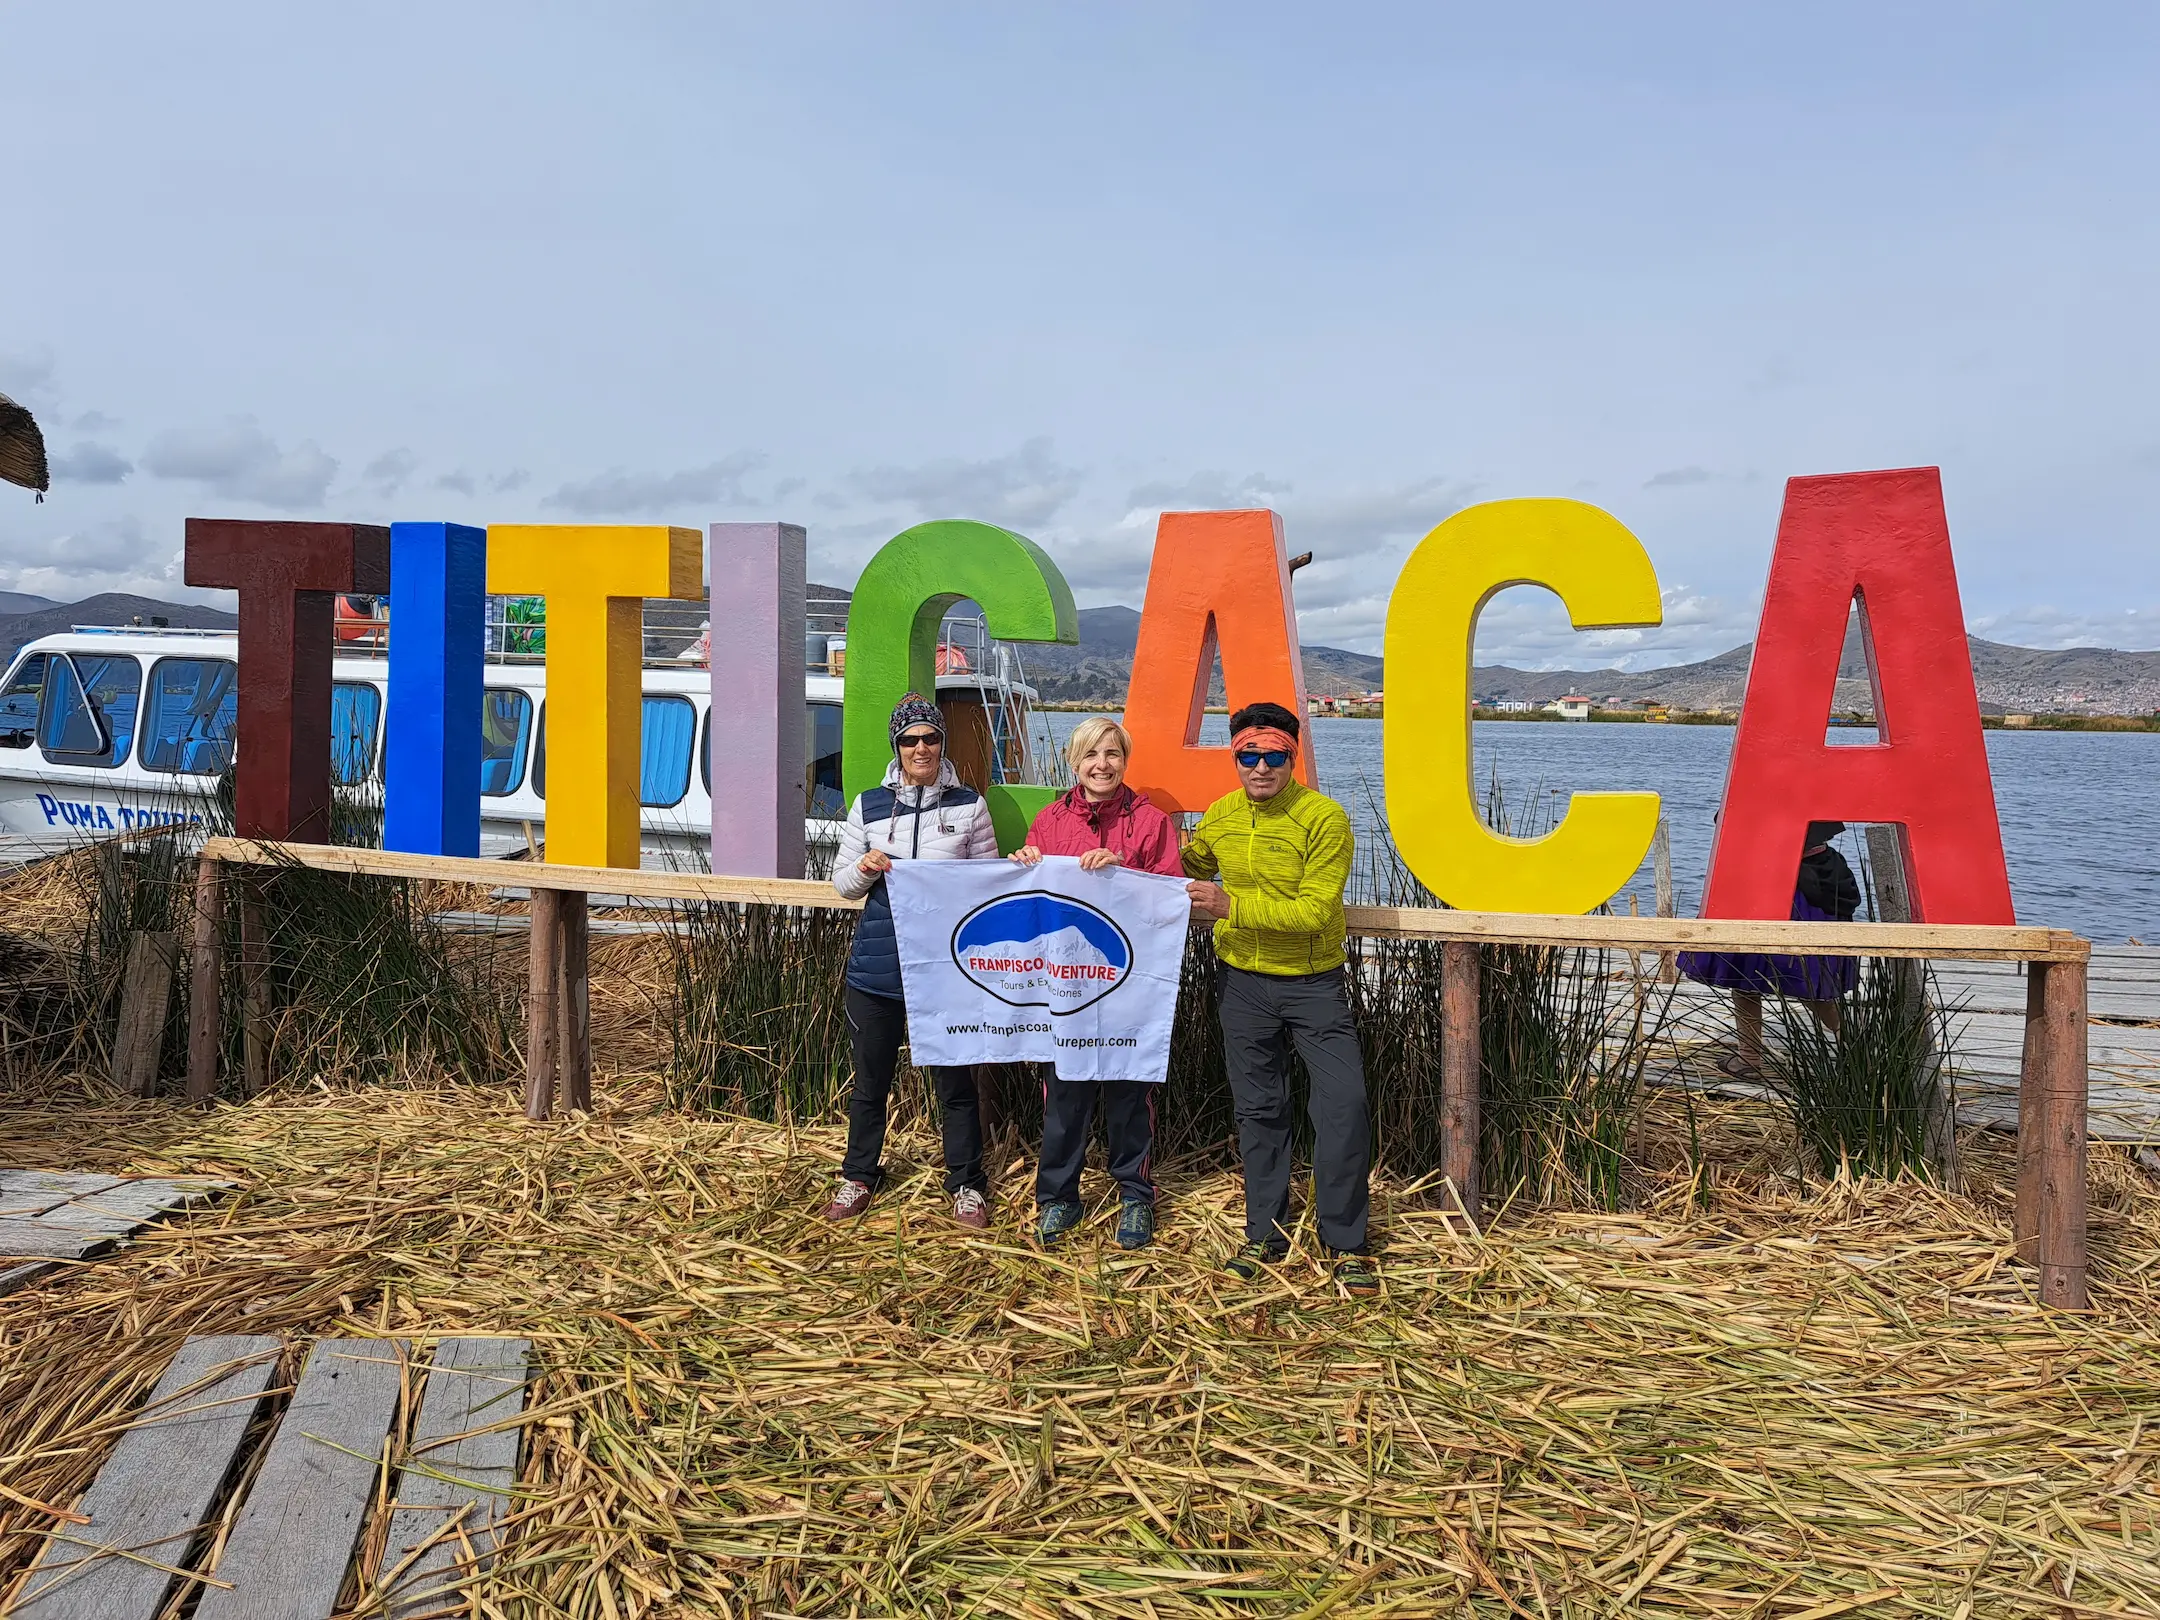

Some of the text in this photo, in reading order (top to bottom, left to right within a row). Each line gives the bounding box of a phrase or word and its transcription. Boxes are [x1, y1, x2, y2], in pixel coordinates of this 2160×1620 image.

[184, 466, 2015, 925] TITICACA
[36, 793, 115, 830] PUMA
[969, 957, 1117, 981] FRANPISCO DVENTURE
[1000, 979, 1024, 990] Tours
[1027, 979, 1035, 988] &
